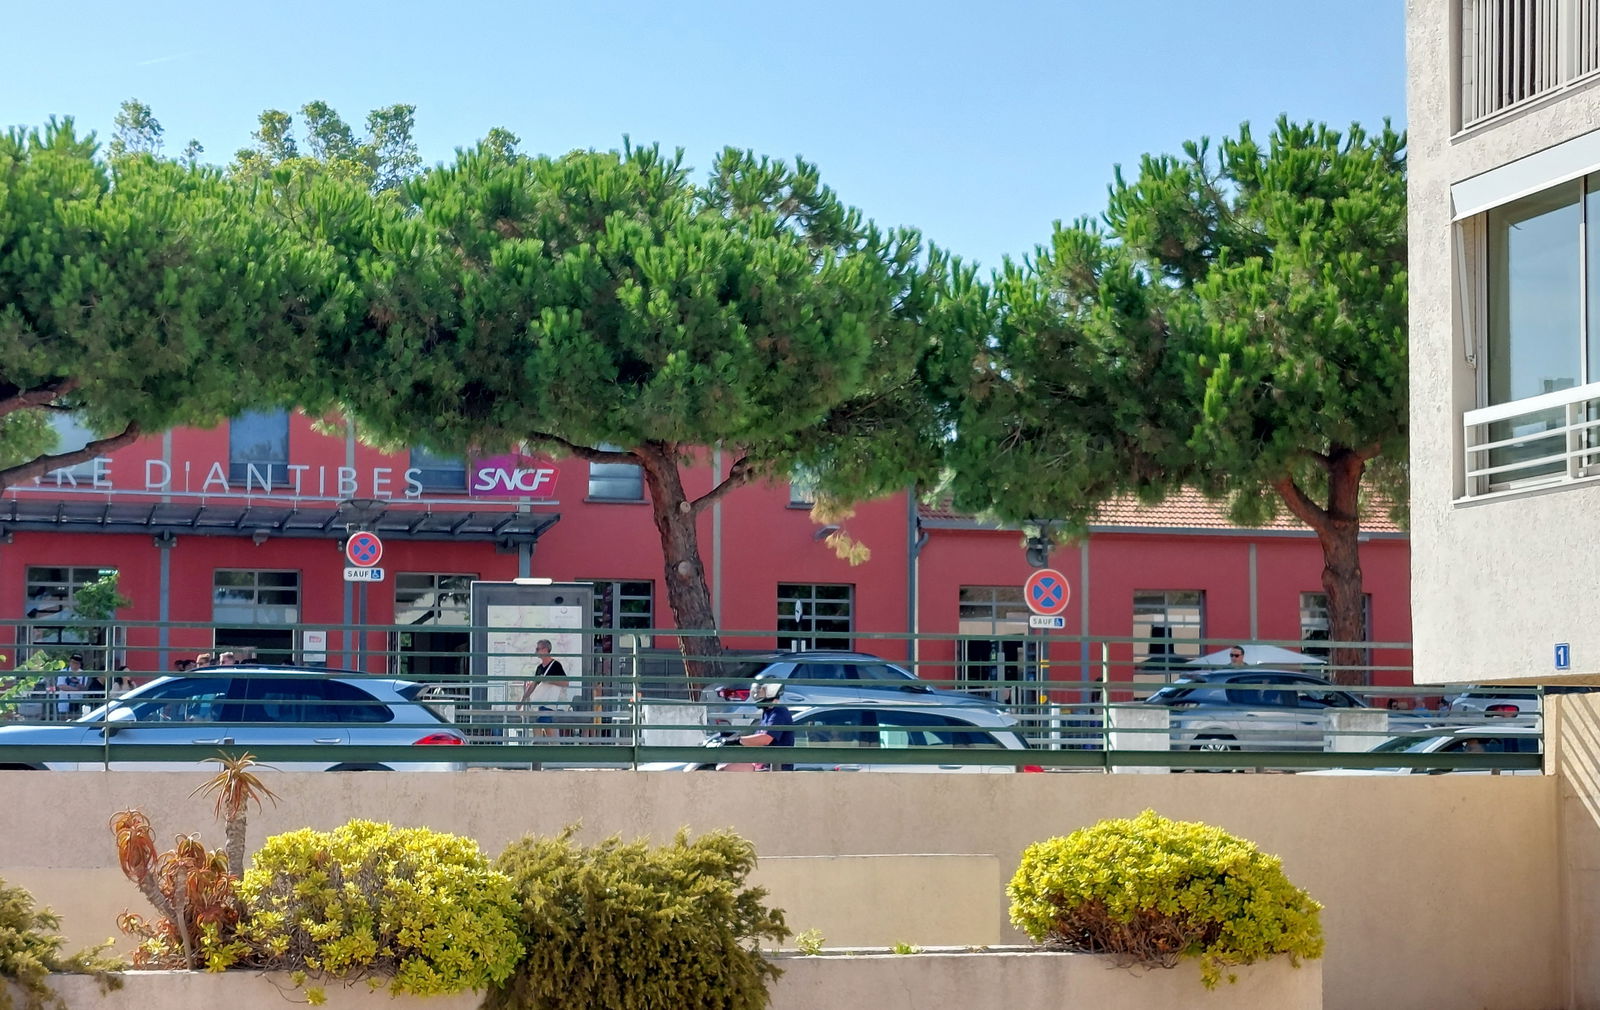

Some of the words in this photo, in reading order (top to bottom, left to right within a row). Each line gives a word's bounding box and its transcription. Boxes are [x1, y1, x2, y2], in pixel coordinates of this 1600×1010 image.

[33, 457, 113, 487] RE
[145, 460, 423, 496] D'ANTIBES
[474, 468, 554, 491] SNCF
[347, 570, 369, 578] SAUF
[1557, 646, 1565, 666] 1
